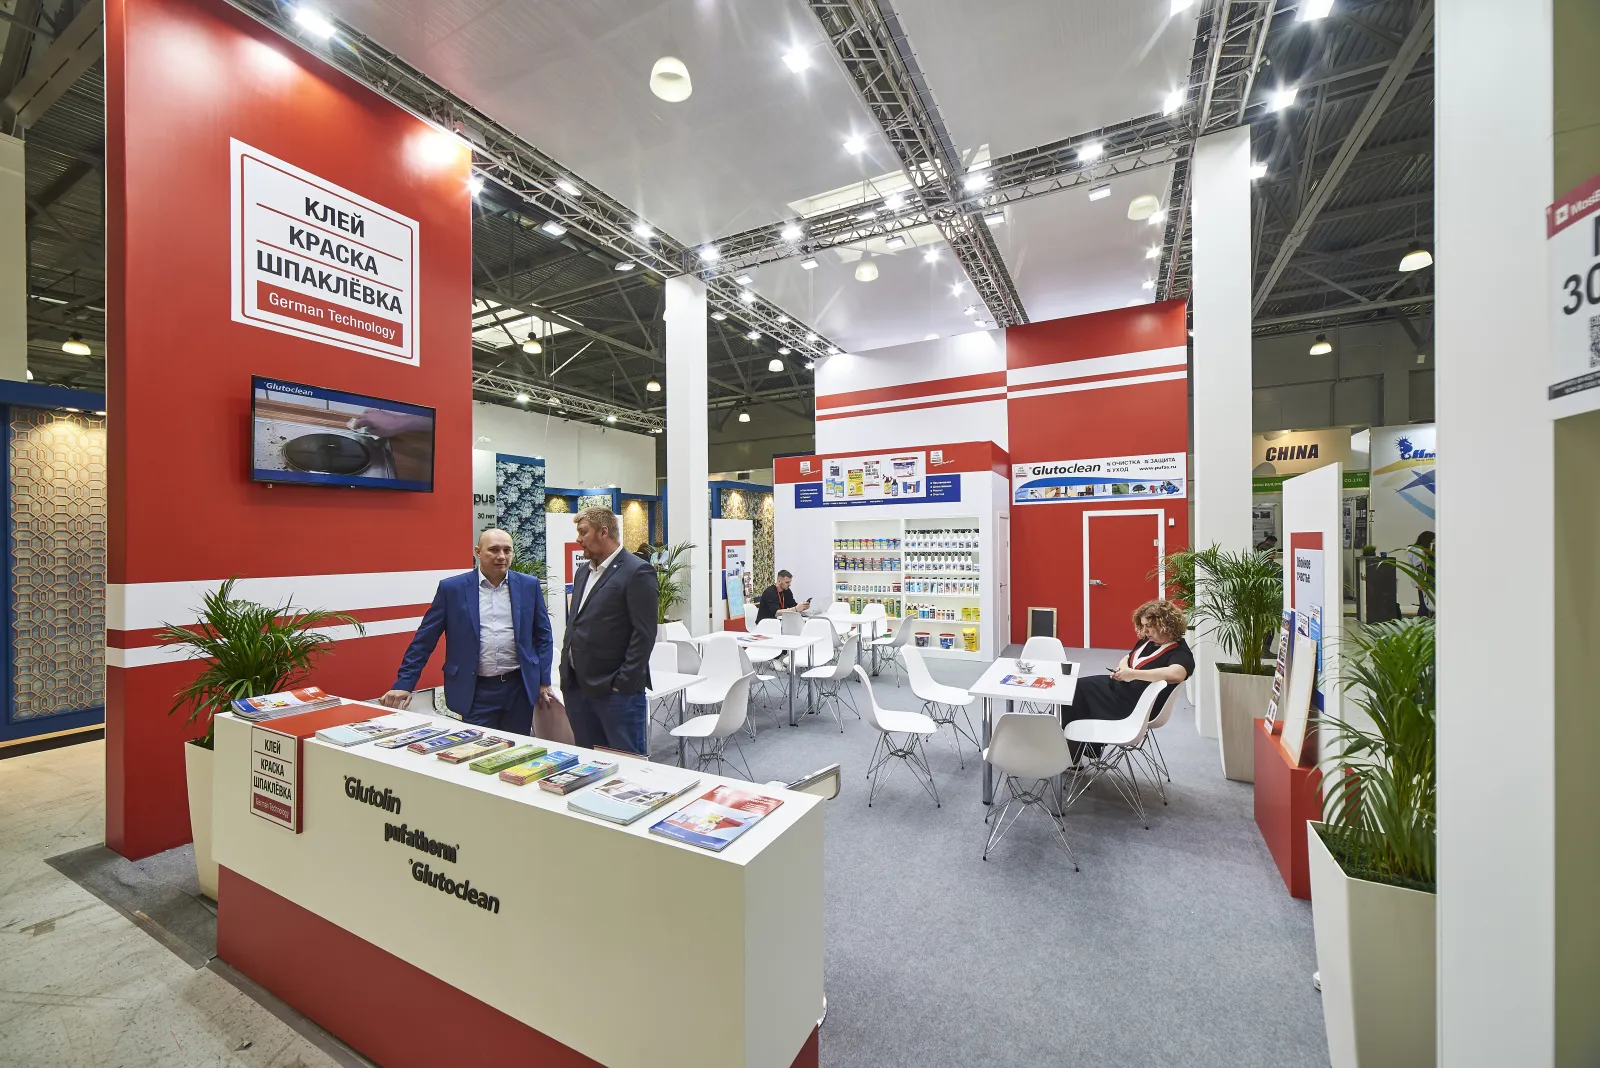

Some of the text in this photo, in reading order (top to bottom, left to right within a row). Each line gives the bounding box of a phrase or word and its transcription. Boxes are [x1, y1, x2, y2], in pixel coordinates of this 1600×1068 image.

[305, 196, 365, 238] КЛЕЙ
[289, 225, 378, 275] КРАСКА
[257, 249, 403, 314] ШПАКЛЁВКА
[269, 292, 396, 340] German Technology
[265, 382, 313, 396] Glutoclean
[1265, 444, 1319, 462] CHINA
[1032, 463, 1101, 476] Glutoclean
[264, 739, 281, 755] КЛЕЙ
[260, 757, 285, 777] КРАСКА
[253, 775, 292, 801] ШПАКЛЁВКА
[344, 776, 402, 815] Glutolin
[255, 797, 290, 818] German Technology
[384, 822, 458, 864] pufatherm
[411, 861, 501, 914] Glutoclean
